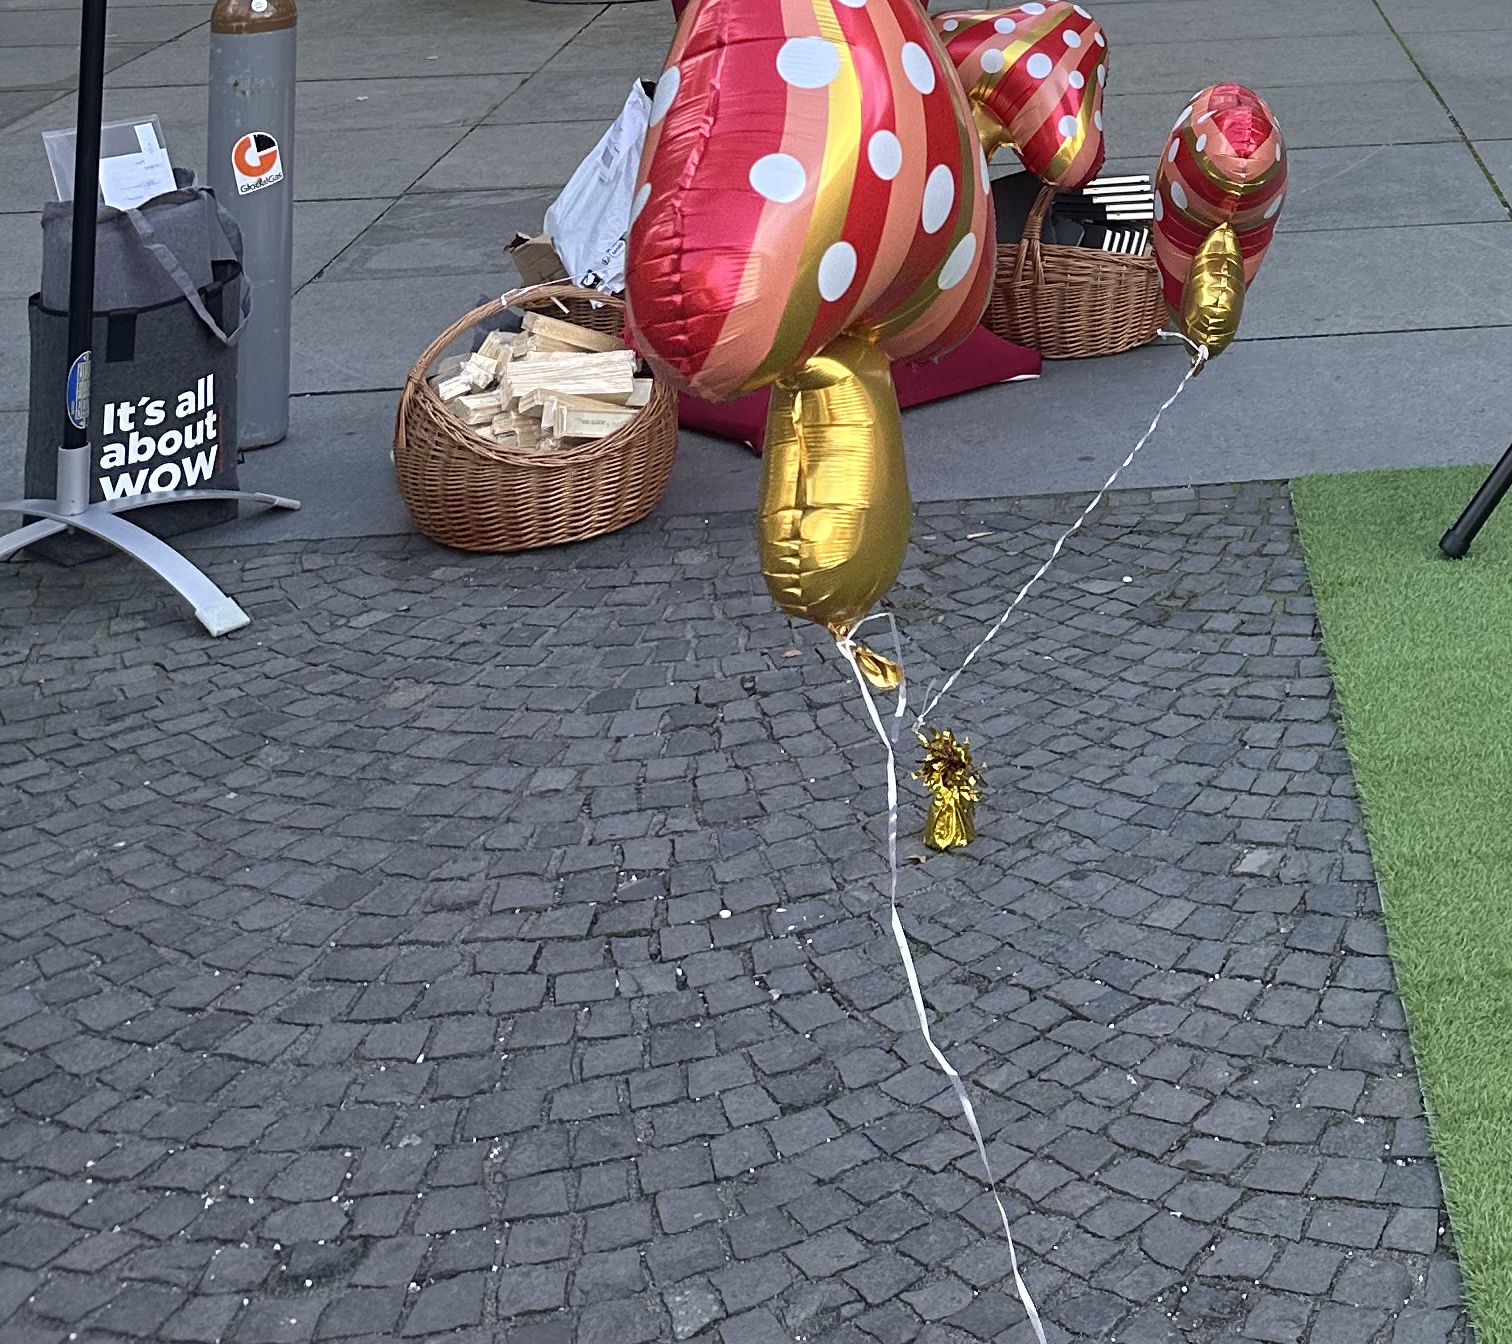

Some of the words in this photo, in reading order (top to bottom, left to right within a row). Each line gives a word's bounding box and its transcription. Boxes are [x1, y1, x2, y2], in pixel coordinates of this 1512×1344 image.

[175, 373, 214, 418] all
[100, 410, 217, 469] about
[99, 444, 218, 501] WOW
